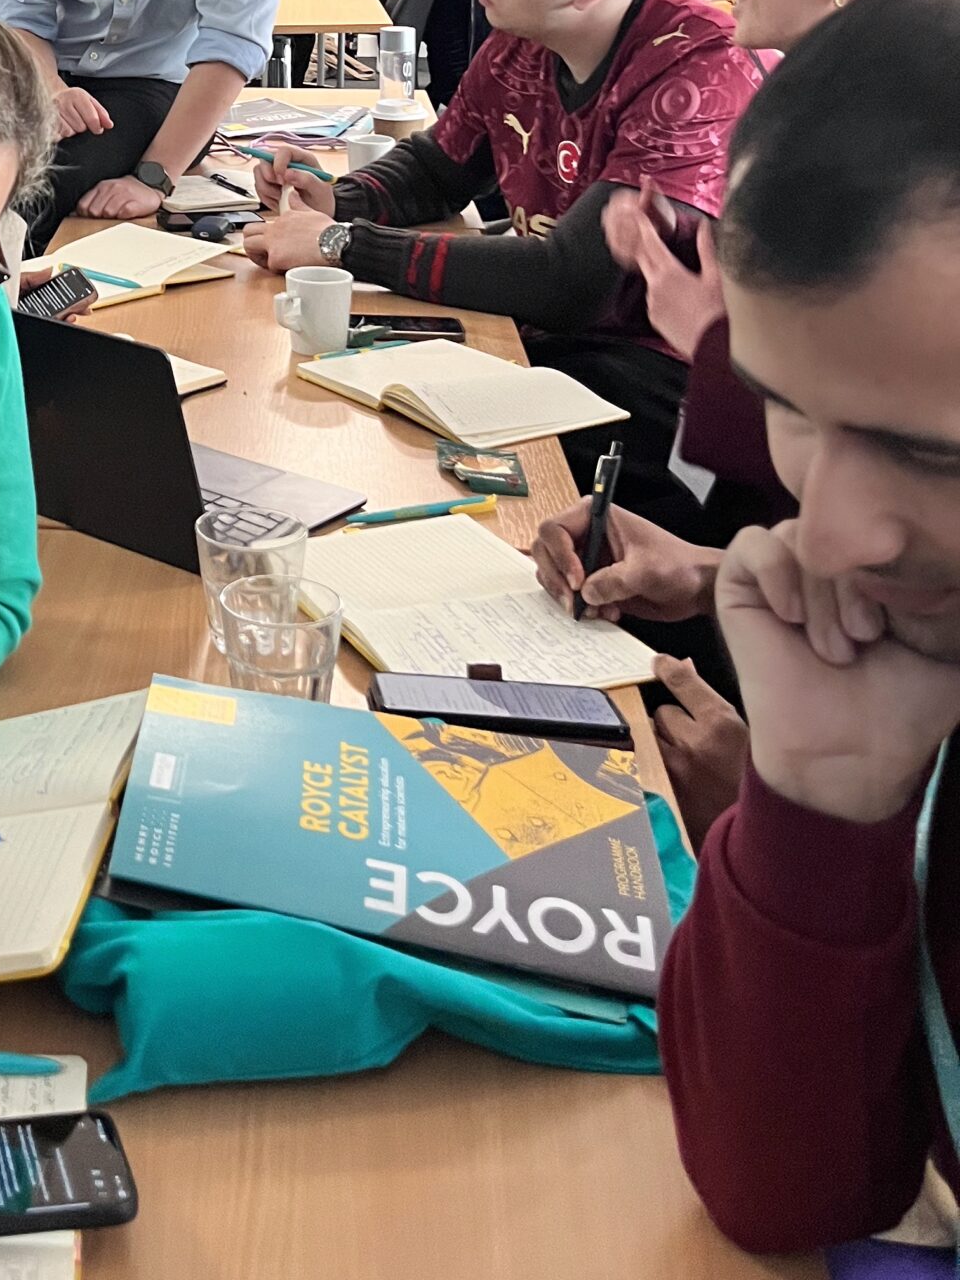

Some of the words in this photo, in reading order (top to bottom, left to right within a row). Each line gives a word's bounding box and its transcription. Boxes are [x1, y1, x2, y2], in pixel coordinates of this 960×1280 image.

[299, 760, 333, 833] ROYCE
[337, 741, 370, 841] CATALYST
[134, 824, 149, 862] HENRY
[149, 827, 163, 865] ROYCE
[163, 812, 181, 868] INSTITUTE
[608, 836, 631, 897] PROGRAMME
[624, 844, 647, 900] HANDBOOK
[363, 858, 657, 973] ROYCE
